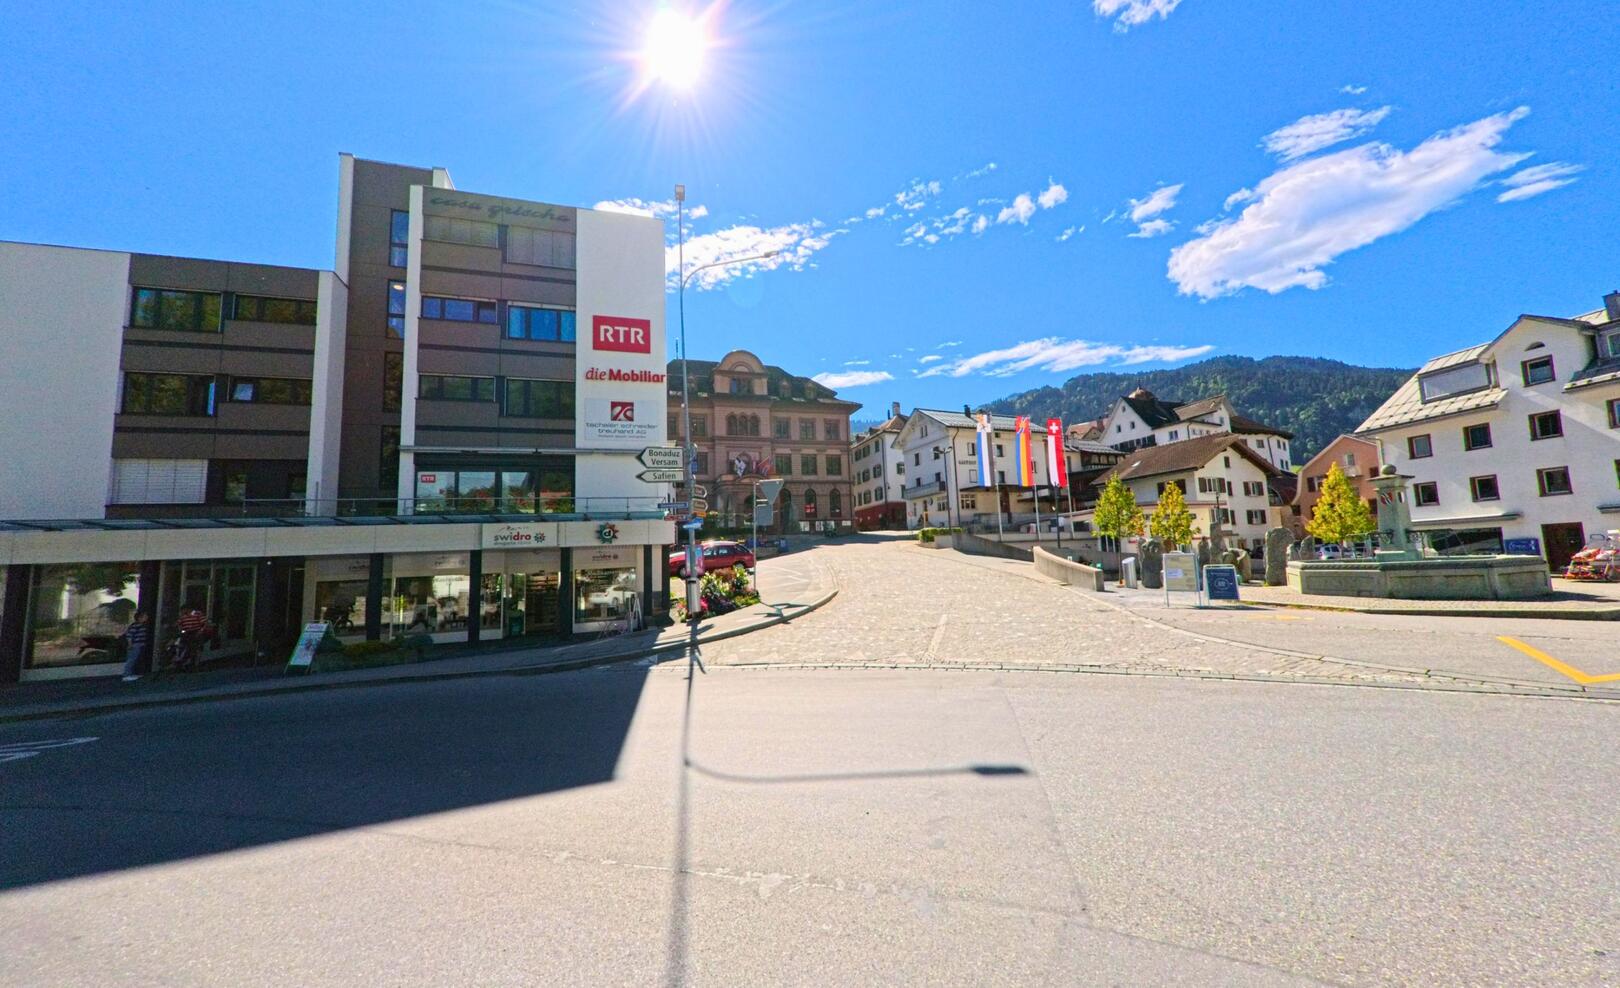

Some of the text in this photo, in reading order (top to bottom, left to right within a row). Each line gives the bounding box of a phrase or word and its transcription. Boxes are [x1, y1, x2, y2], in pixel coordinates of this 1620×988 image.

[599, 324, 645, 345] RTR
[585, 367, 667, 383] die Mobiliar
[648, 449, 680, 458] Bonaduz
[650, 458, 678, 466] Versam
[652, 472, 677, 480] Safien
[493, 531, 532, 542] swidro
